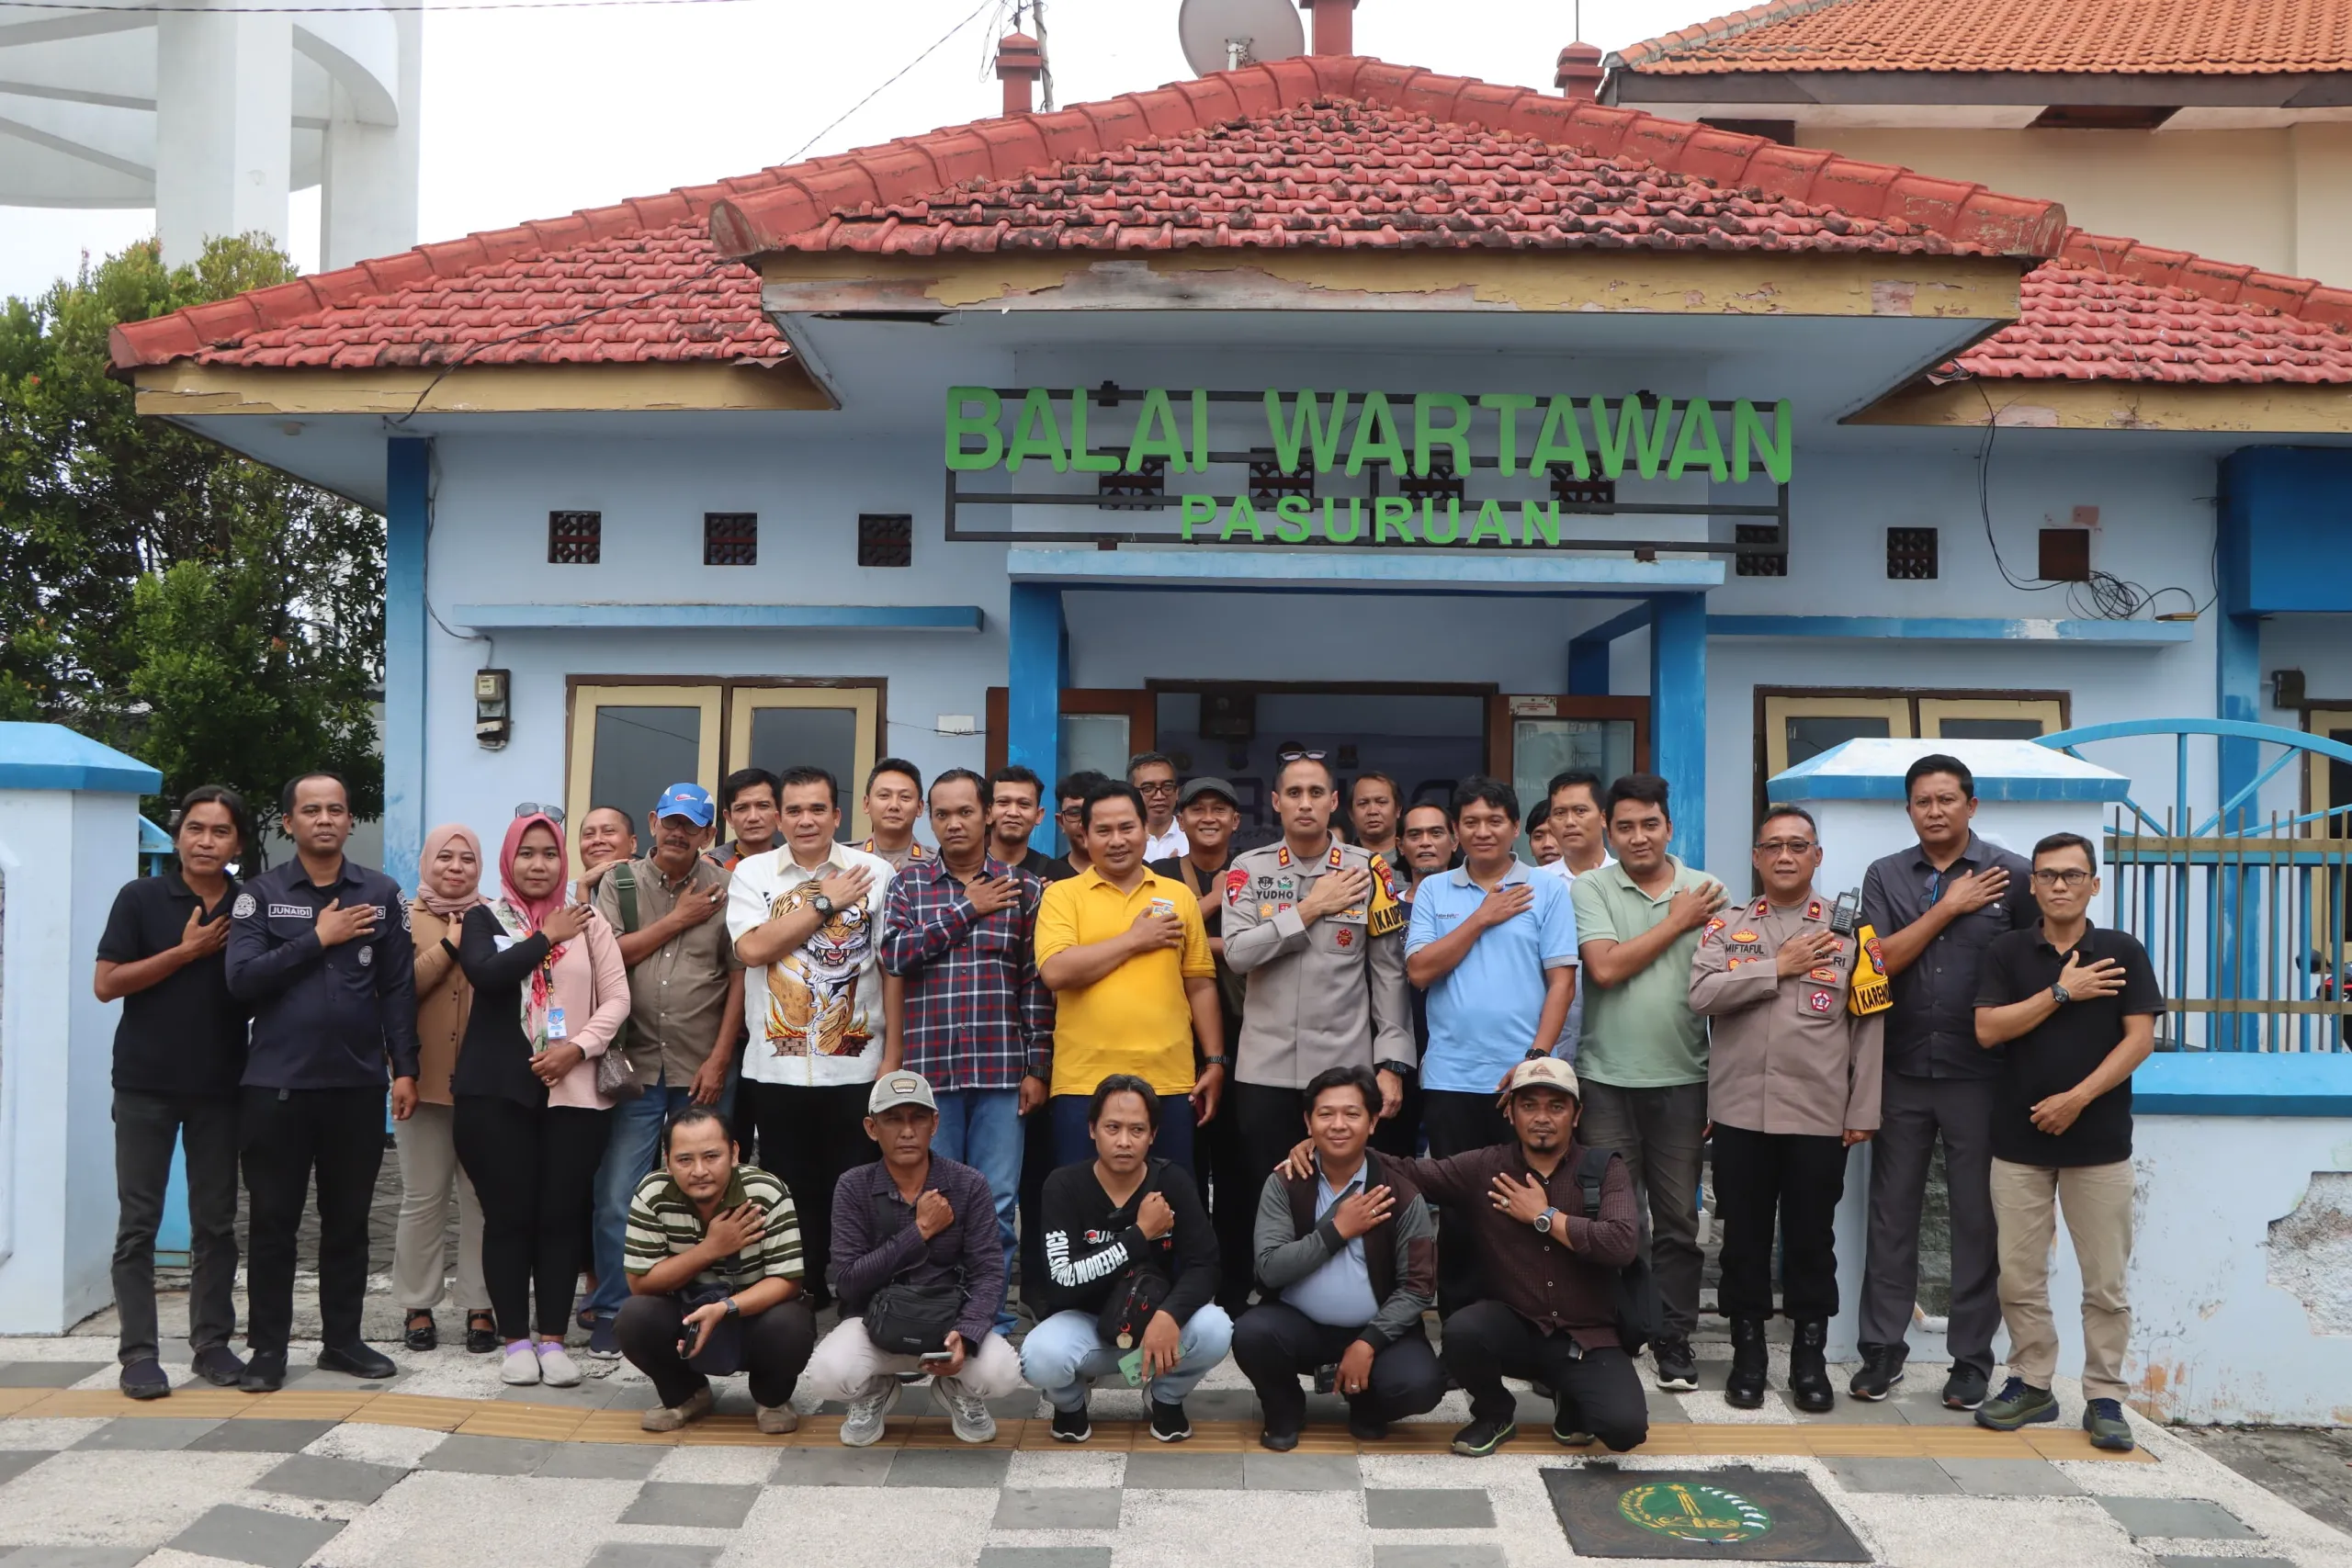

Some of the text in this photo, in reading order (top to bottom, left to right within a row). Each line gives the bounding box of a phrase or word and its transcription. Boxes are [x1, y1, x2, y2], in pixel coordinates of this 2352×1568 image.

[945, 386, 1792, 484] BALAI WARTAWAN
[1182, 494, 1560, 546] PASURUAN
[1256, 890, 1294, 899] YUDHO
[271, 907, 310, 916] JUNAIDI
[1725, 943, 1764, 954] MIFTAFUL
